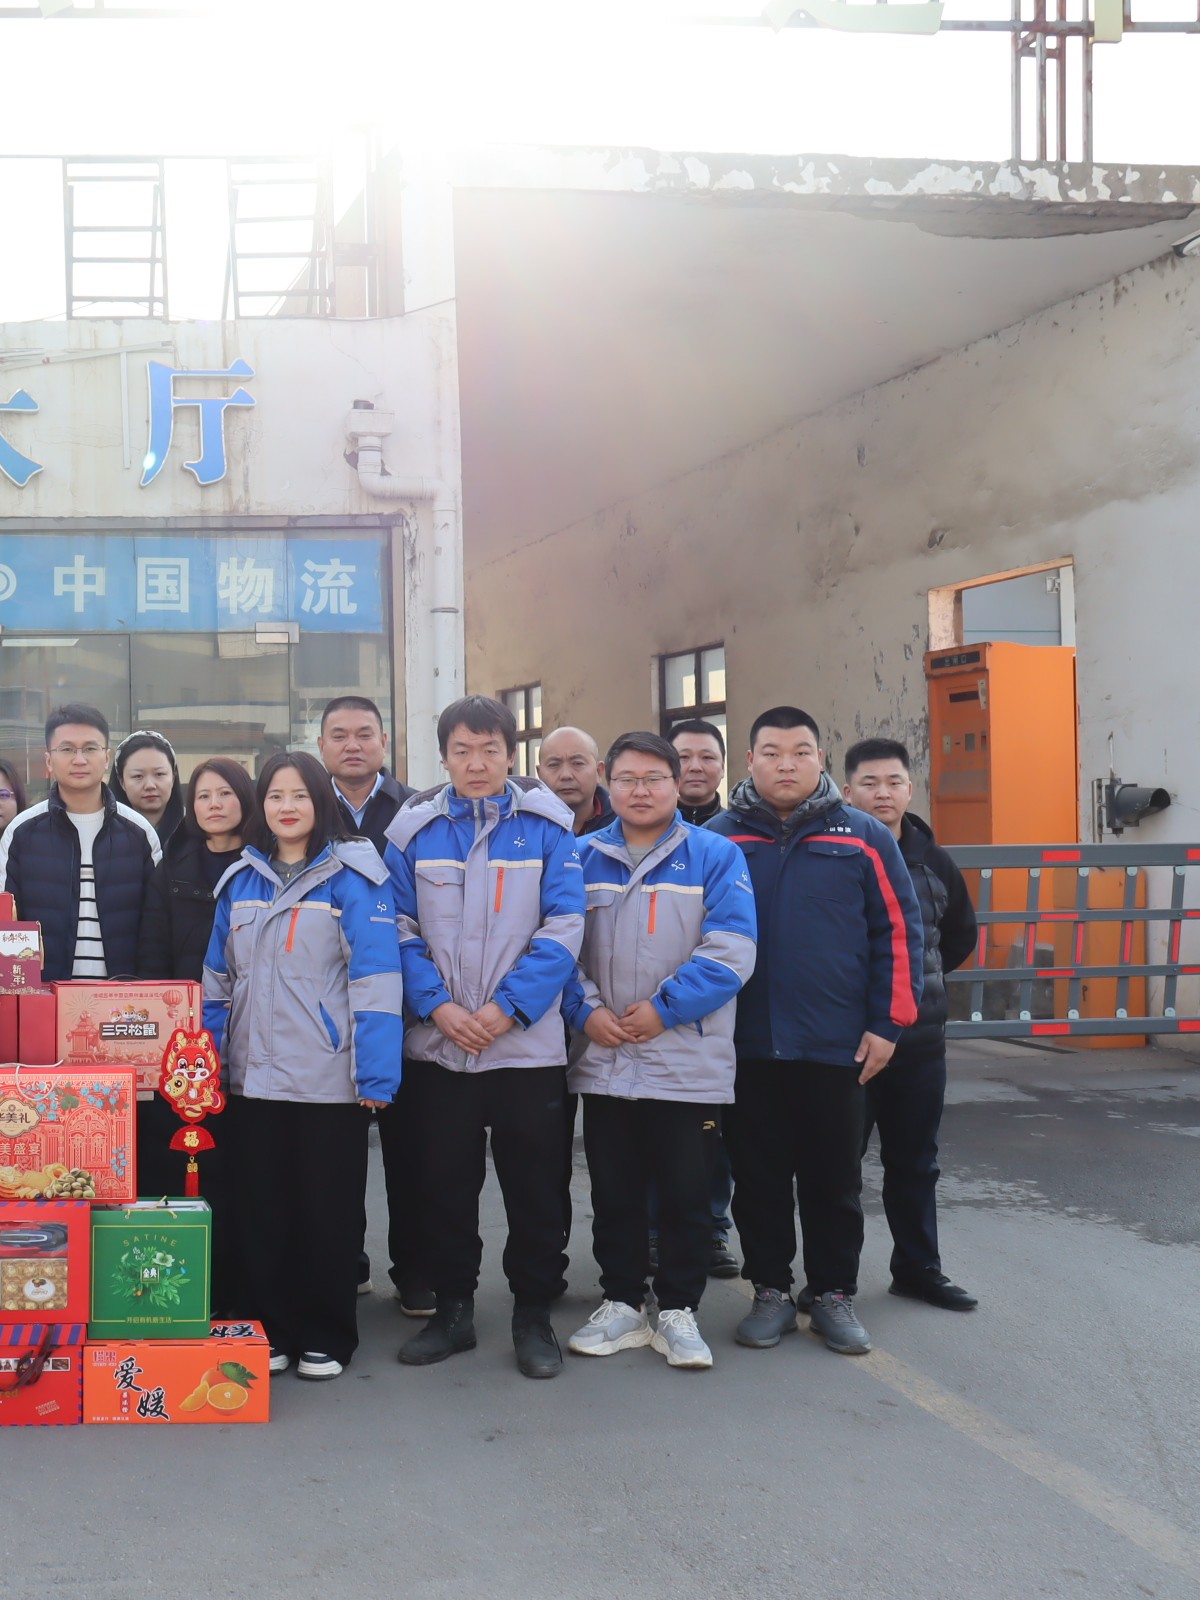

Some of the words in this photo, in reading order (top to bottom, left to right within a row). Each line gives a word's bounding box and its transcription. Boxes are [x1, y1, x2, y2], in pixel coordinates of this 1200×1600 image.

[53, 555, 358, 615] 中国物流
[102, 1023, 157, 1037] 三只松鼠
[183, 1131, 200, 1148] 福
[123, 1234, 178, 1247] SATINE
[143, 1267, 157, 1279] 金典
[114, 1356, 171, 1422] 爱媛
